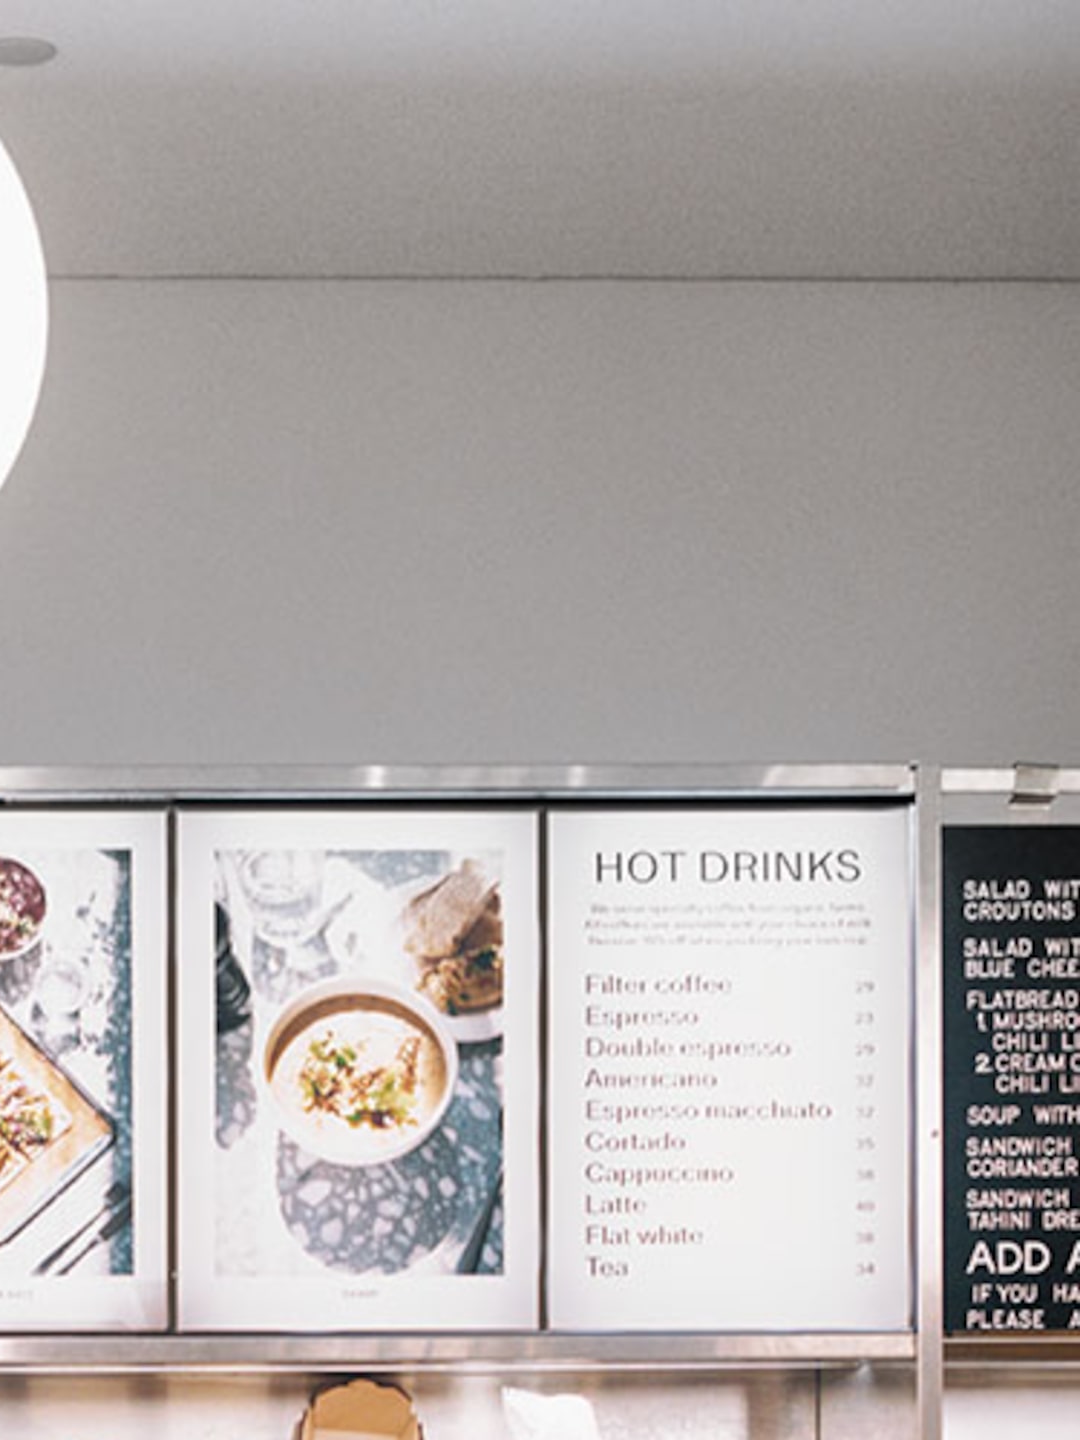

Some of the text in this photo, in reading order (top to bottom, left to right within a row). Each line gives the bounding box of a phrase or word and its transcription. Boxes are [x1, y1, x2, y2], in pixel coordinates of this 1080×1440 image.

[595, 850, 861, 883] HOT DRINKS
[964, 880, 1080, 900] SALAD WIT
[964, 901, 1075, 921] CROUTONS
[964, 938, 1080, 958] SALAD WIT
[965, 958, 1014, 978] BLUE
[586, 975, 645, 994] Filter
[654, 975, 731, 995] coffee
[967, 990, 1078, 1012] FLATBREAD
[586, 1006, 698, 1030] Espresso
[586, 1037, 672, 1057] Double
[680, 1043, 791, 1060] espresso
[992, 1032, 1047, 1052] CHILI
[995, 1053, 1065, 1073] CREAM
[585, 1069, 717, 1088] Americano
[995, 1074, 1049, 1093] CHILI
[586, 1100, 699, 1123] Espresso
[705, 1100, 832, 1120] macchiato
[967, 1105, 1020, 1126] SOUP
[585, 1132, 685, 1152] Cortado
[966, 1137, 1071, 1157] SANDWICH
[585, 1162, 733, 1187] Cappuccino
[967, 1157, 1078, 1178] CORIANDER
[586, 1195, 645, 1214] Latte
[966, 1189, 1069, 1209] SANDWICH
[967, 1211, 1030, 1230] TAHINI
[586, 1226, 628, 1244] Flat
[637, 1226, 702, 1244] white
[585, 1256, 629, 1277] Tea
[966, 1241, 1050, 1274] ADD
[972, 1283, 992, 1303] IF
[996, 1284, 1038, 1303] YOU
[967, 1309, 1044, 1330] PLEASE
